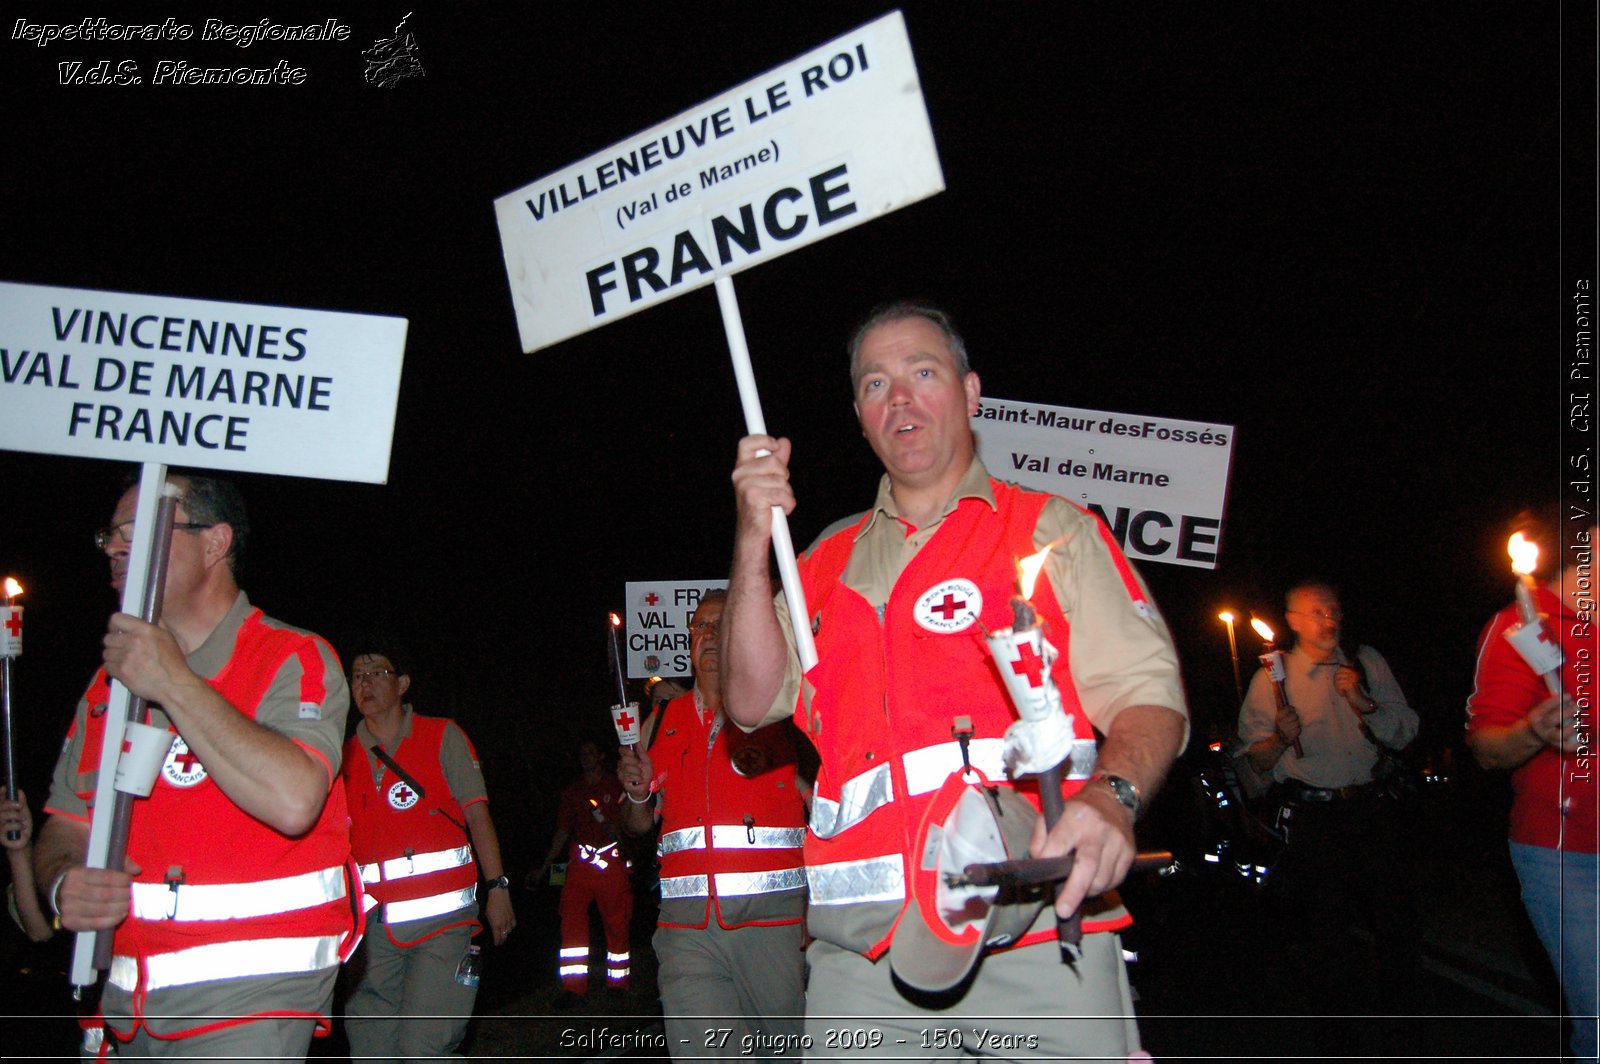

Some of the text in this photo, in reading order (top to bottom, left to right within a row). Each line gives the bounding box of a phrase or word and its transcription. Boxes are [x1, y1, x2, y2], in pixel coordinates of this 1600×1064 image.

[525, 43, 870, 223] VILLENEUVE LE ROI
[615, 139, 781, 230] (Val de Marne)
[584, 162, 858, 318] FRANCE
[51, 306, 308, 362] VINCENNES
[0, 348, 334, 412] VAL DE MARNE
[68, 401, 251, 452] FRANCE
[1011, 453, 1170, 488] Val de Marne
[1086, 502, 1221, 564] NCE
[637, 611, 676, 630] VAL
[674, 588, 703, 607] FR
[629, 633, 692, 652] CHAR
[673, 654, 692, 673] S
[169, 739, 186, 754] CRO
